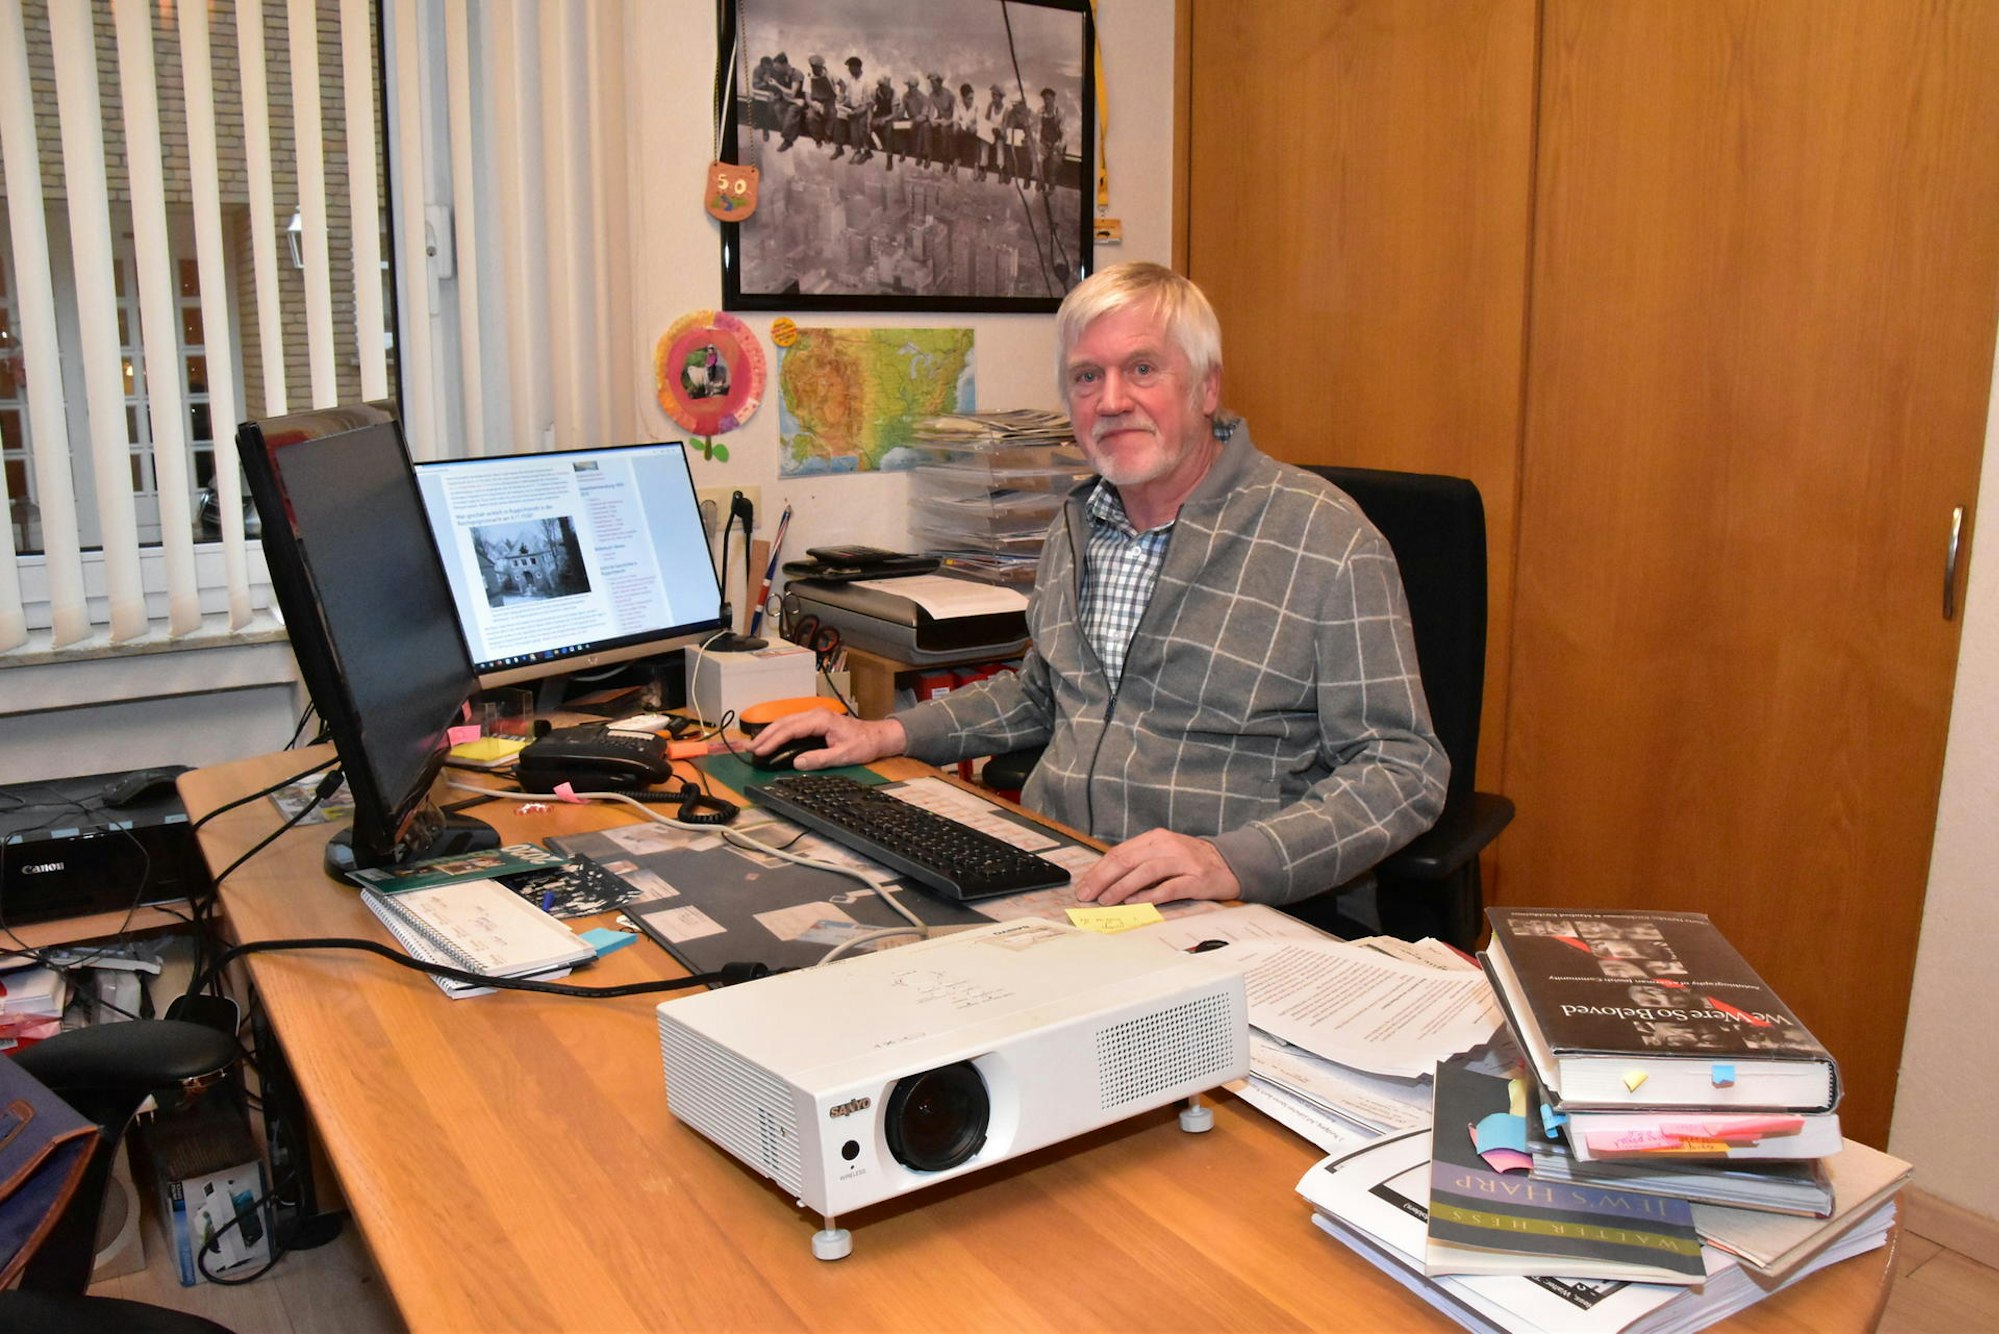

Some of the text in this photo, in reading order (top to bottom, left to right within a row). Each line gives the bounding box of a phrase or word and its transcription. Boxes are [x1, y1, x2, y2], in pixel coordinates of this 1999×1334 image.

[21, 861, 65, 875] Canon
[1548, 975, 1603, 983] Community
[1691, 980, 1760, 990] Autobiography
[1560, 1004, 1794, 1026] We Were So Beloved
[829, 1097, 872, 1118] SANYO
[1455, 1174, 1667, 1218] JEW'S HARP
[1452, 1210, 1680, 1251] WALTER HESS
